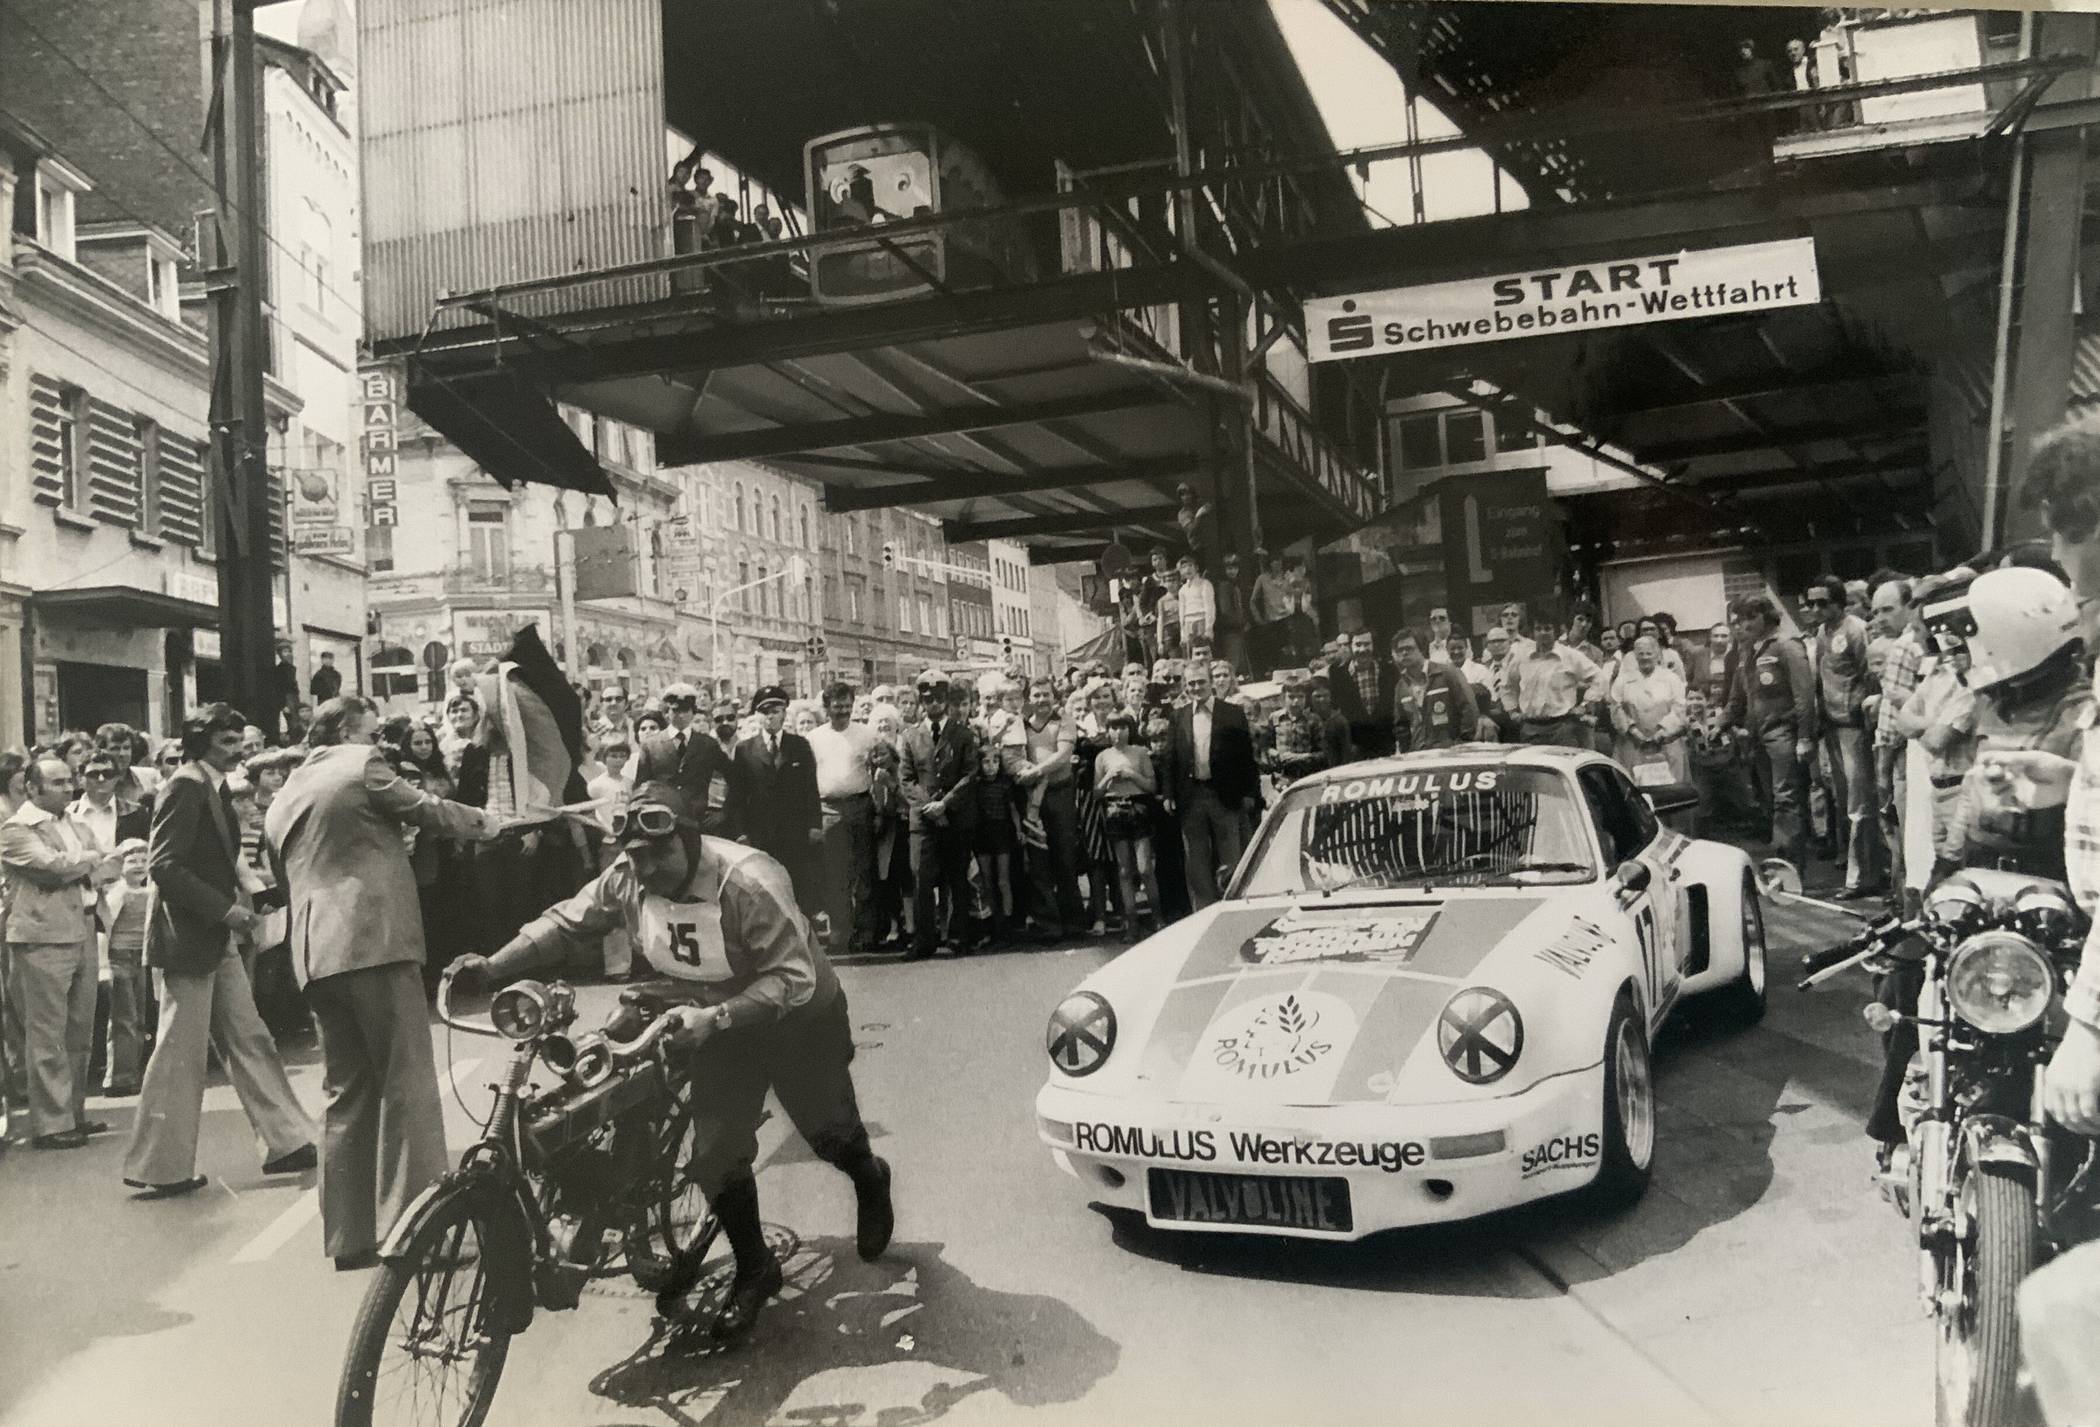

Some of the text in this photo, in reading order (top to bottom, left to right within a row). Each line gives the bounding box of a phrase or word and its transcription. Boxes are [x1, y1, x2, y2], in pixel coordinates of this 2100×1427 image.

[1493, 258, 1680, 307] START
[1383, 275, 1799, 346] Schwebebahn-Wettfahrt
[367, 380, 395, 526] BARMER
[1320, 770, 1498, 805] ROMULUS
[1075, 1121, 1425, 1173] ROMULUS Werkzeuge
[1521, 1132, 1600, 1173] SACHS
[1162, 1171, 1338, 1231] VALVOLINE
